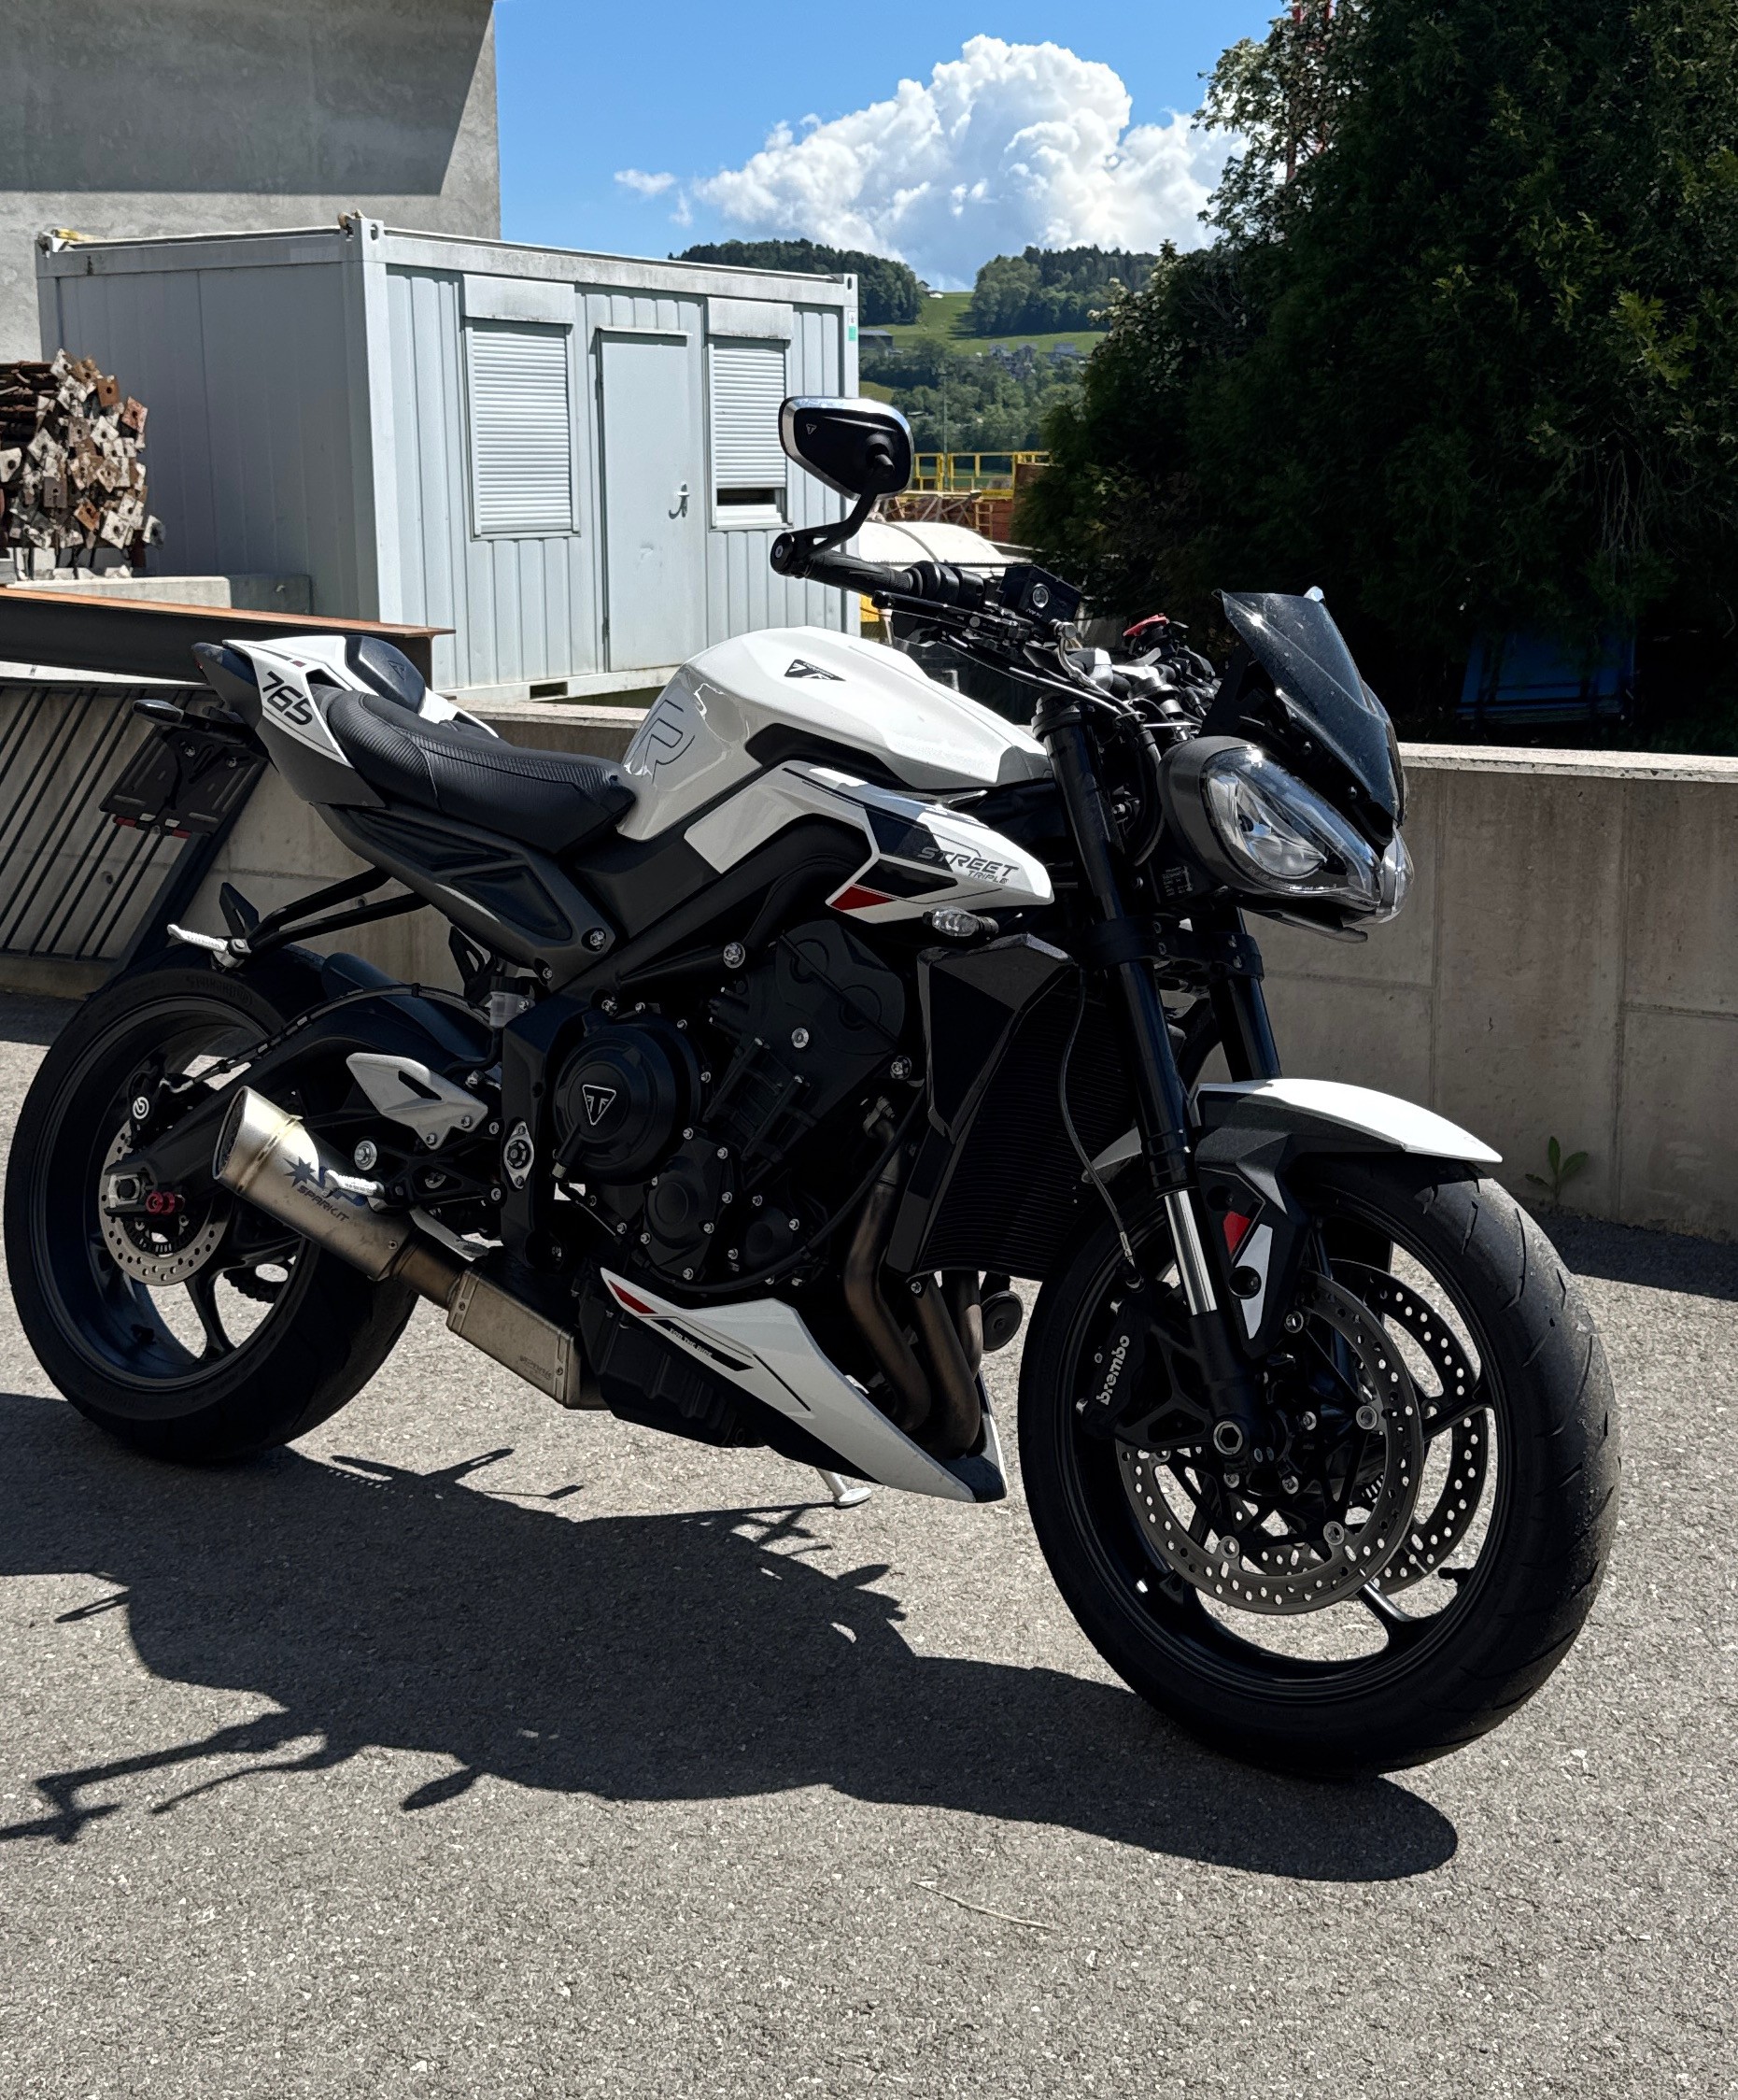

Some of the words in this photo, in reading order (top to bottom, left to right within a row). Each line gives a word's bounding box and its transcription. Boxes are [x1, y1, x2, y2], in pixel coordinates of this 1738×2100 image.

[262, 670, 313, 726] 765
[917, 845, 1020, 877] STREET
[968, 870, 1009, 885] TRIPLE
[1095, 1335, 1130, 1406] brembo
